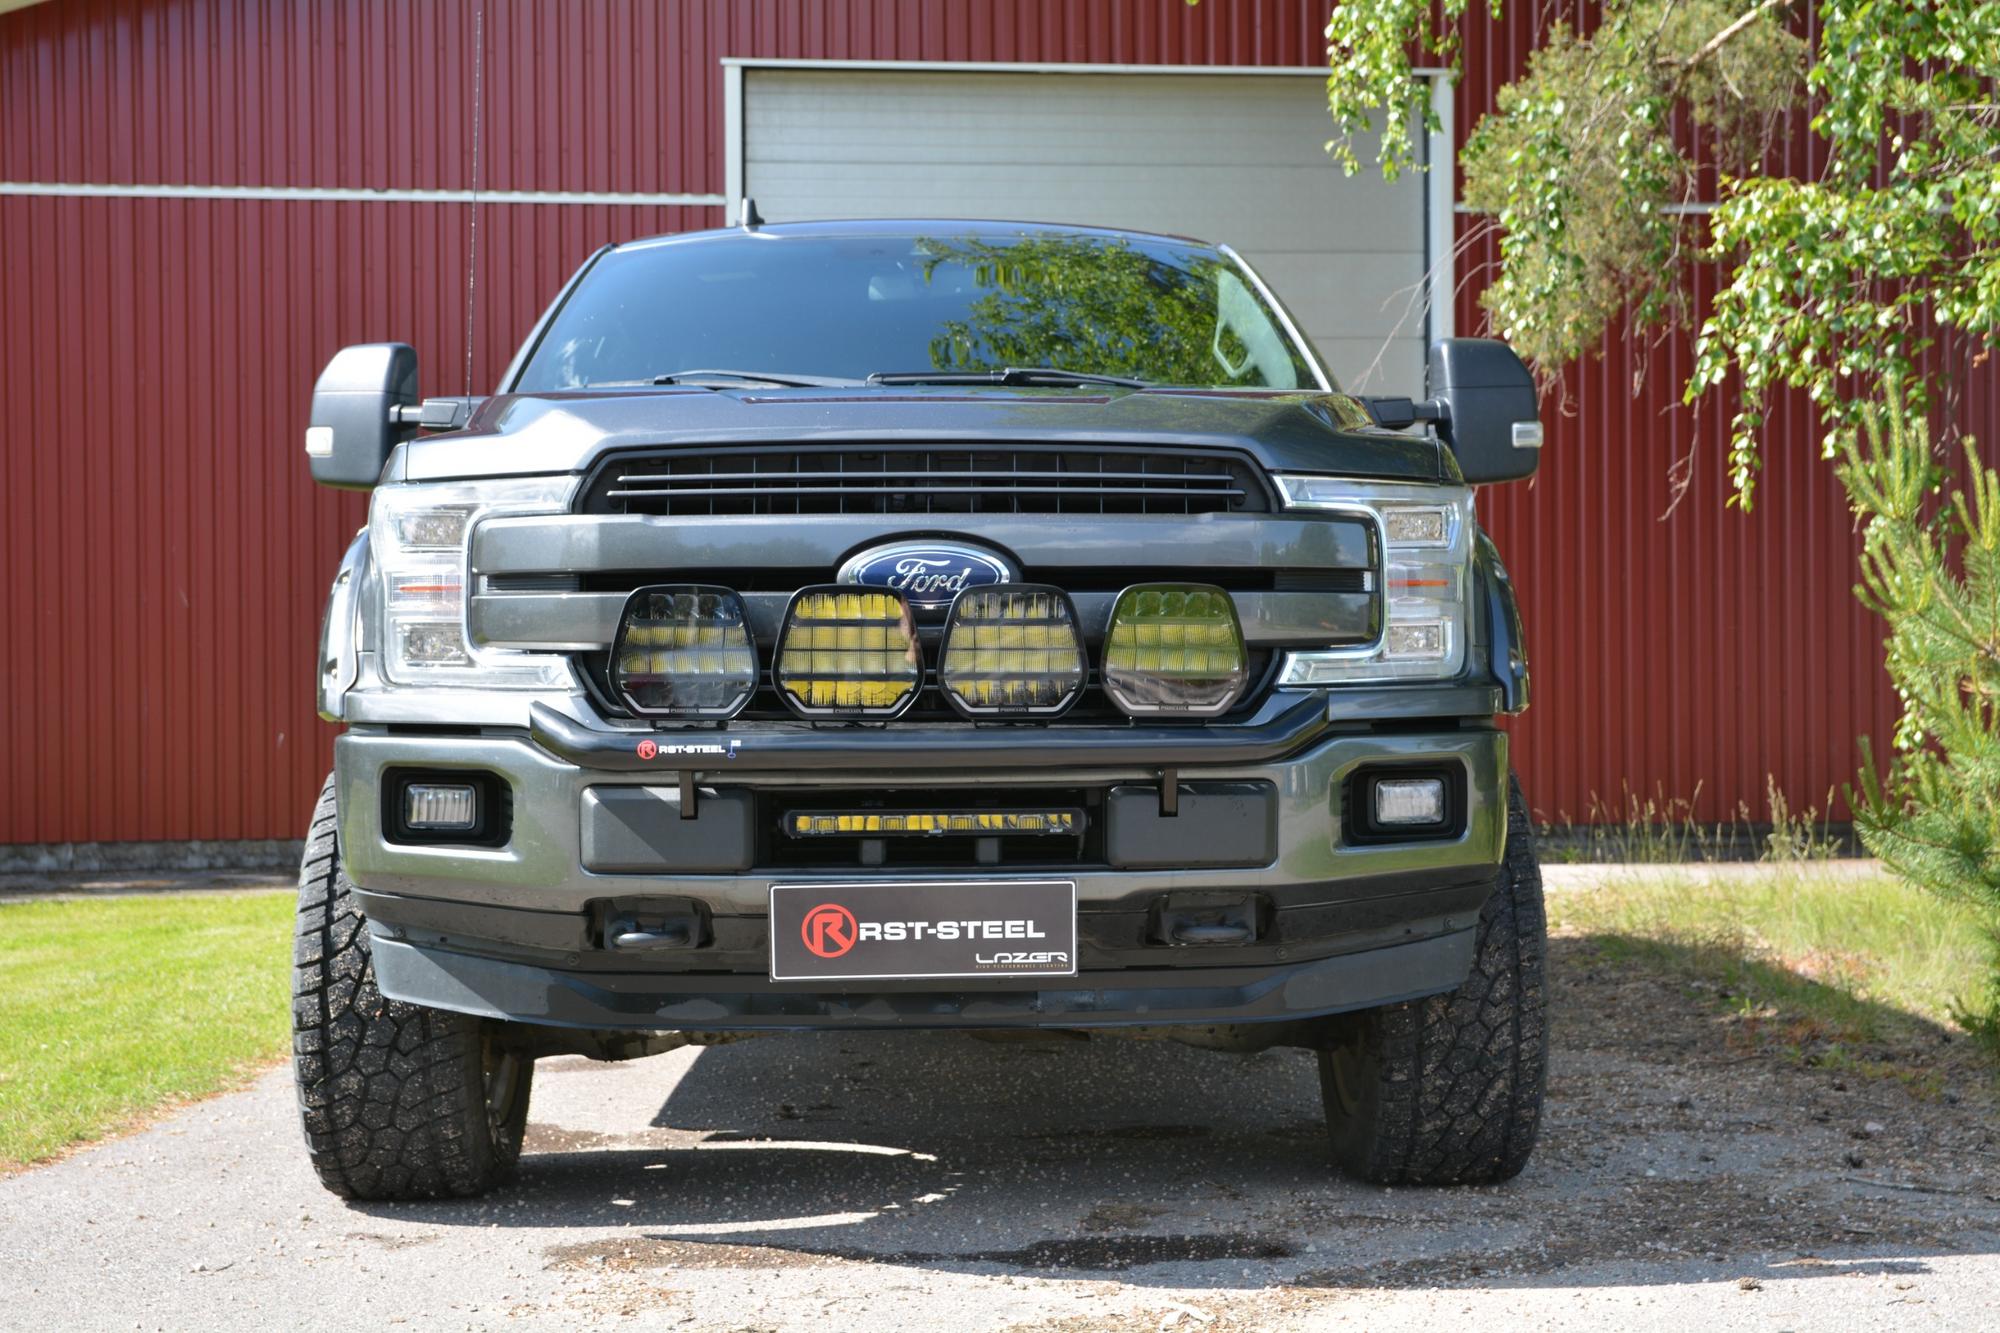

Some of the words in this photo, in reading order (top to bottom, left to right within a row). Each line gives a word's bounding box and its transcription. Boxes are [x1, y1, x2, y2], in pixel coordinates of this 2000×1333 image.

[887, 558, 972, 593] Ford
[859, 920, 1046, 941] RST-STEEL
[975, 951, 1068, 964] LAZER
